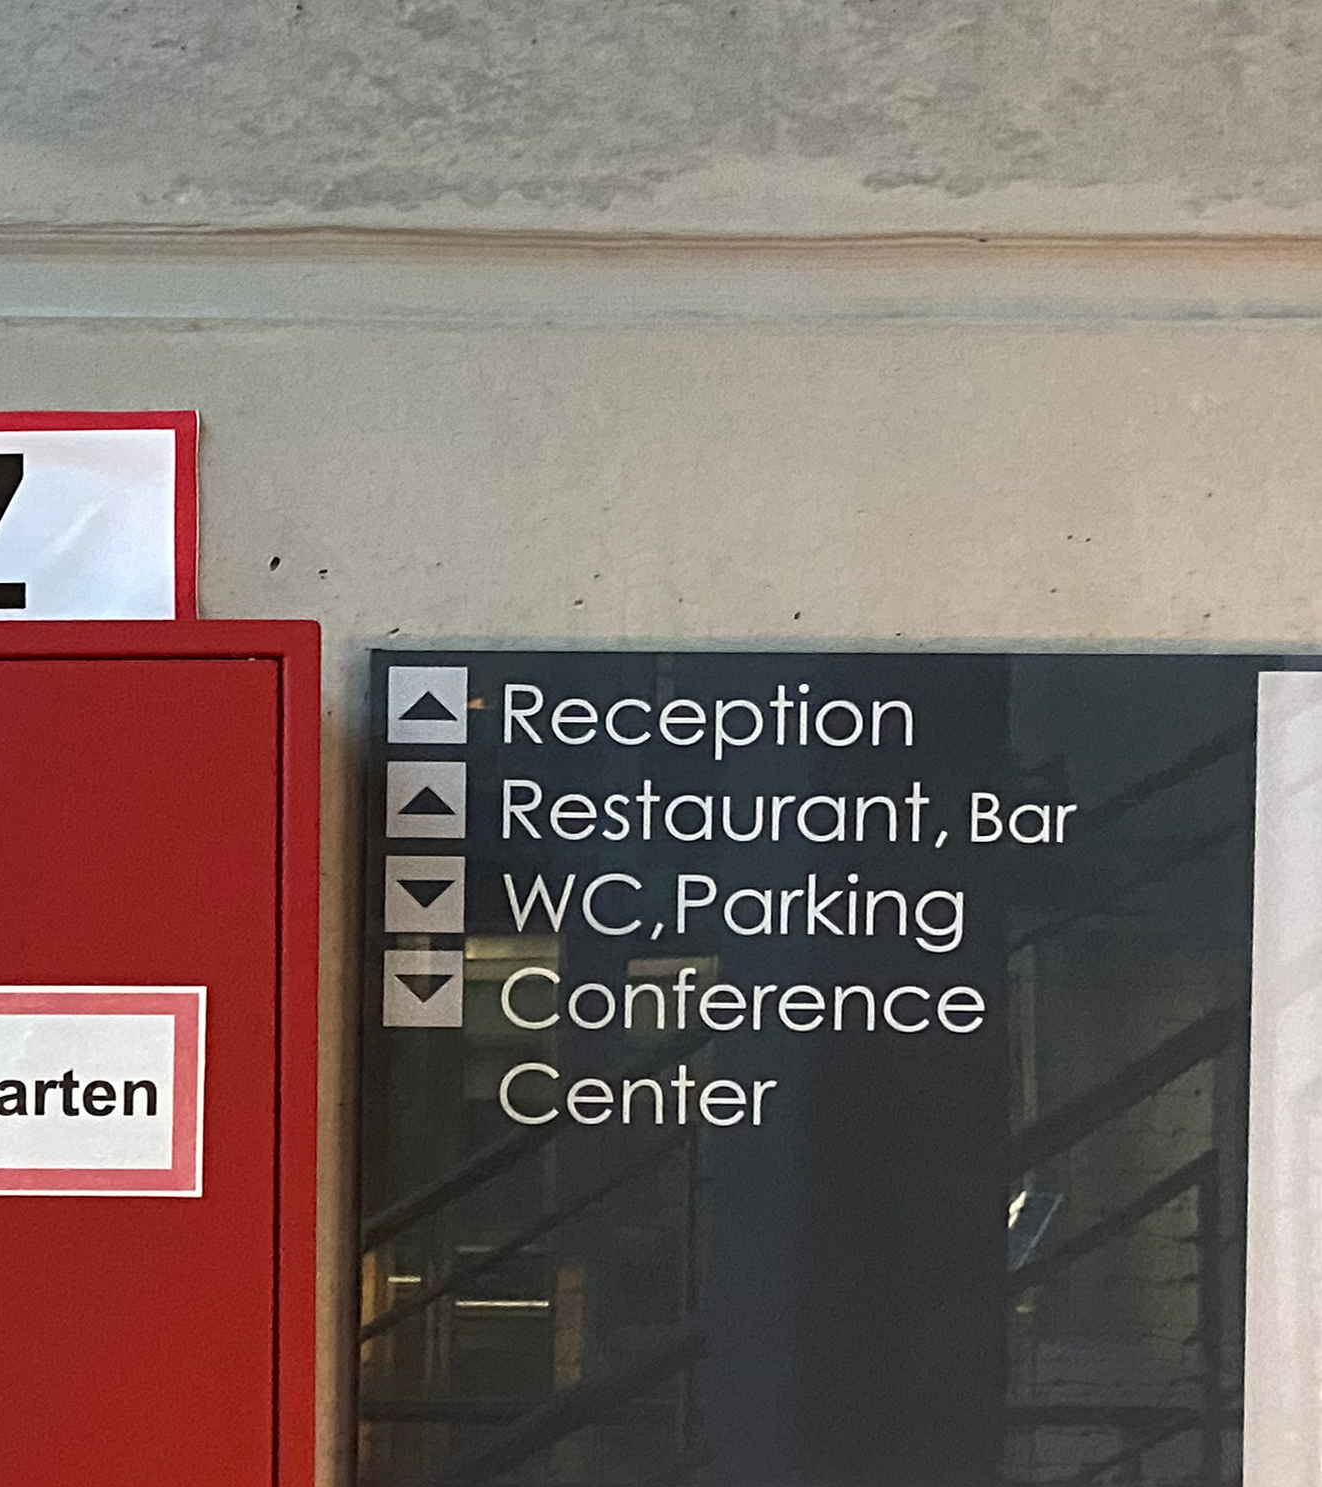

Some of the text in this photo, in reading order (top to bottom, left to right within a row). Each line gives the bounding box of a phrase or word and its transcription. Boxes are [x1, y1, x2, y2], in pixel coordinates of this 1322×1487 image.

[501, 683, 915, 761] Reception
[970, 791, 1078, 845] Bar
[500, 966, 987, 1034] Conference
[499, 1061, 778, 1127] Center
